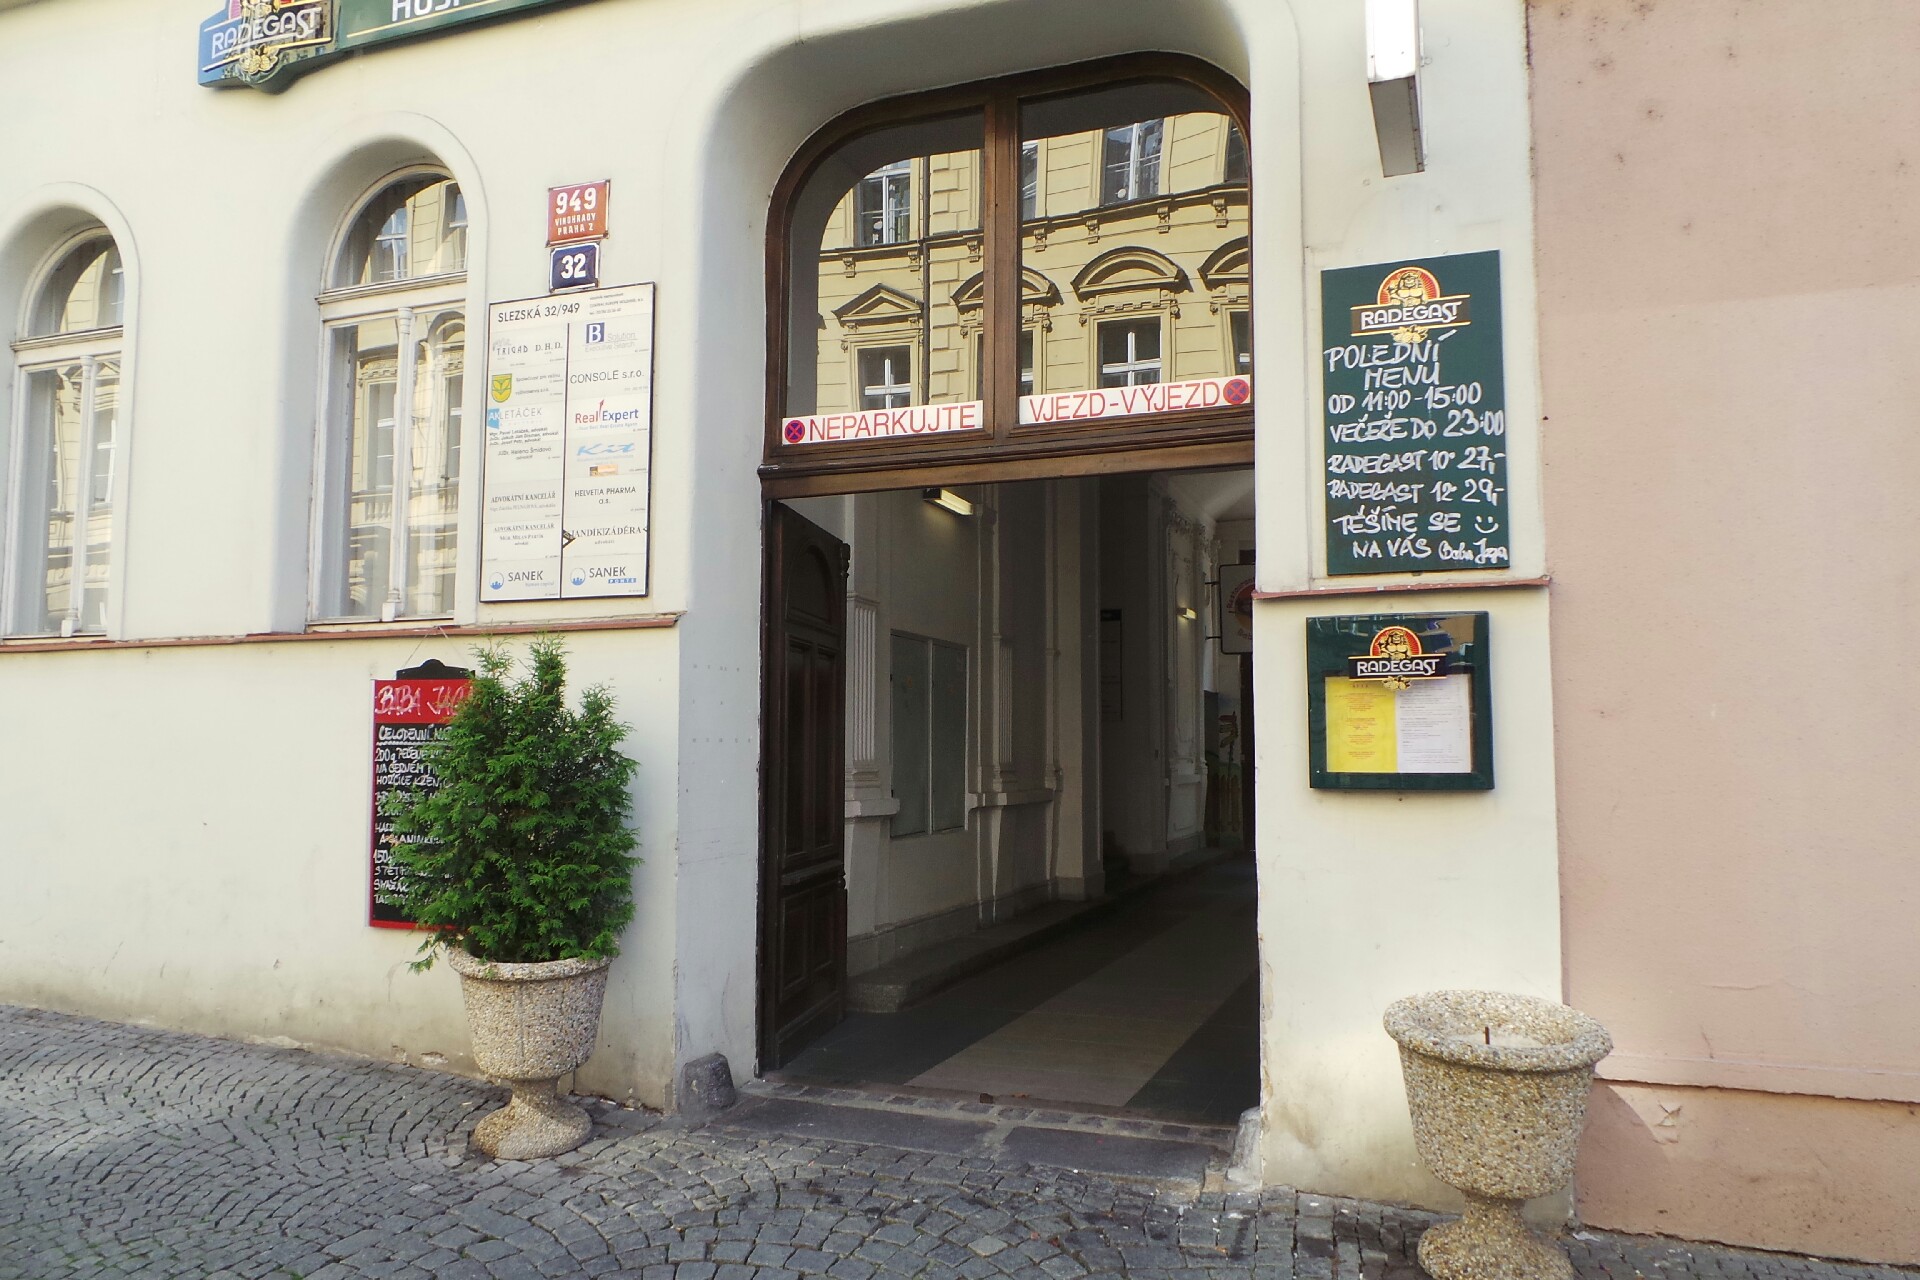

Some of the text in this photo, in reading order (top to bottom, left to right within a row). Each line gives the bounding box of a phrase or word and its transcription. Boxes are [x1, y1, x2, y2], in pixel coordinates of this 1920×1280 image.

[212, 8, 321, 59] RADEGAST
[555, 187, 598, 215] 949
[554, 212, 597, 227] VINOHRADY
[557, 222, 595, 236] PRAHA 2
[560, 253, 587, 279] 32
[497, 305, 541, 323] SLEZSKÁ
[544, 302, 581, 318] 32/949
[1360, 301, 1463, 330] RADEGAST
[587, 323, 602, 343] B
[1323, 329, 1457, 373] POLEDNÍ
[570, 370, 619, 384] CONSOLE
[621, 369, 645, 379] s.r.o.
[1364, 362, 1440, 391] MENU
[498, 407, 542, 420] LETÁČEK
[1328, 394, 1356, 414] OD
[575, 408, 639, 424] Real Expert
[808, 404, 976, 441] NEPARKUJTE
[1330, 409, 1505, 443] VEČEŘE DO 23:00
[1327, 450, 1428, 474] RADEGAST
[491, 491, 556, 503] ADVOKÁTNÍ KANCELÁŘ
[574, 486, 636, 498] HELVETIA PHARMA
[1327, 479, 1424, 503] RADEGAST
[1332, 504, 1461, 535] TĚŠÍME SE
[1352, 540, 1383, 558] NA
[1387, 533, 1432, 558] VÁS
[508, 570, 544, 582] SANEK
[589, 566, 627, 578] SANEK
[1356, 659, 1440, 677] RADEGAST
[375, 763, 387, 774] NA
